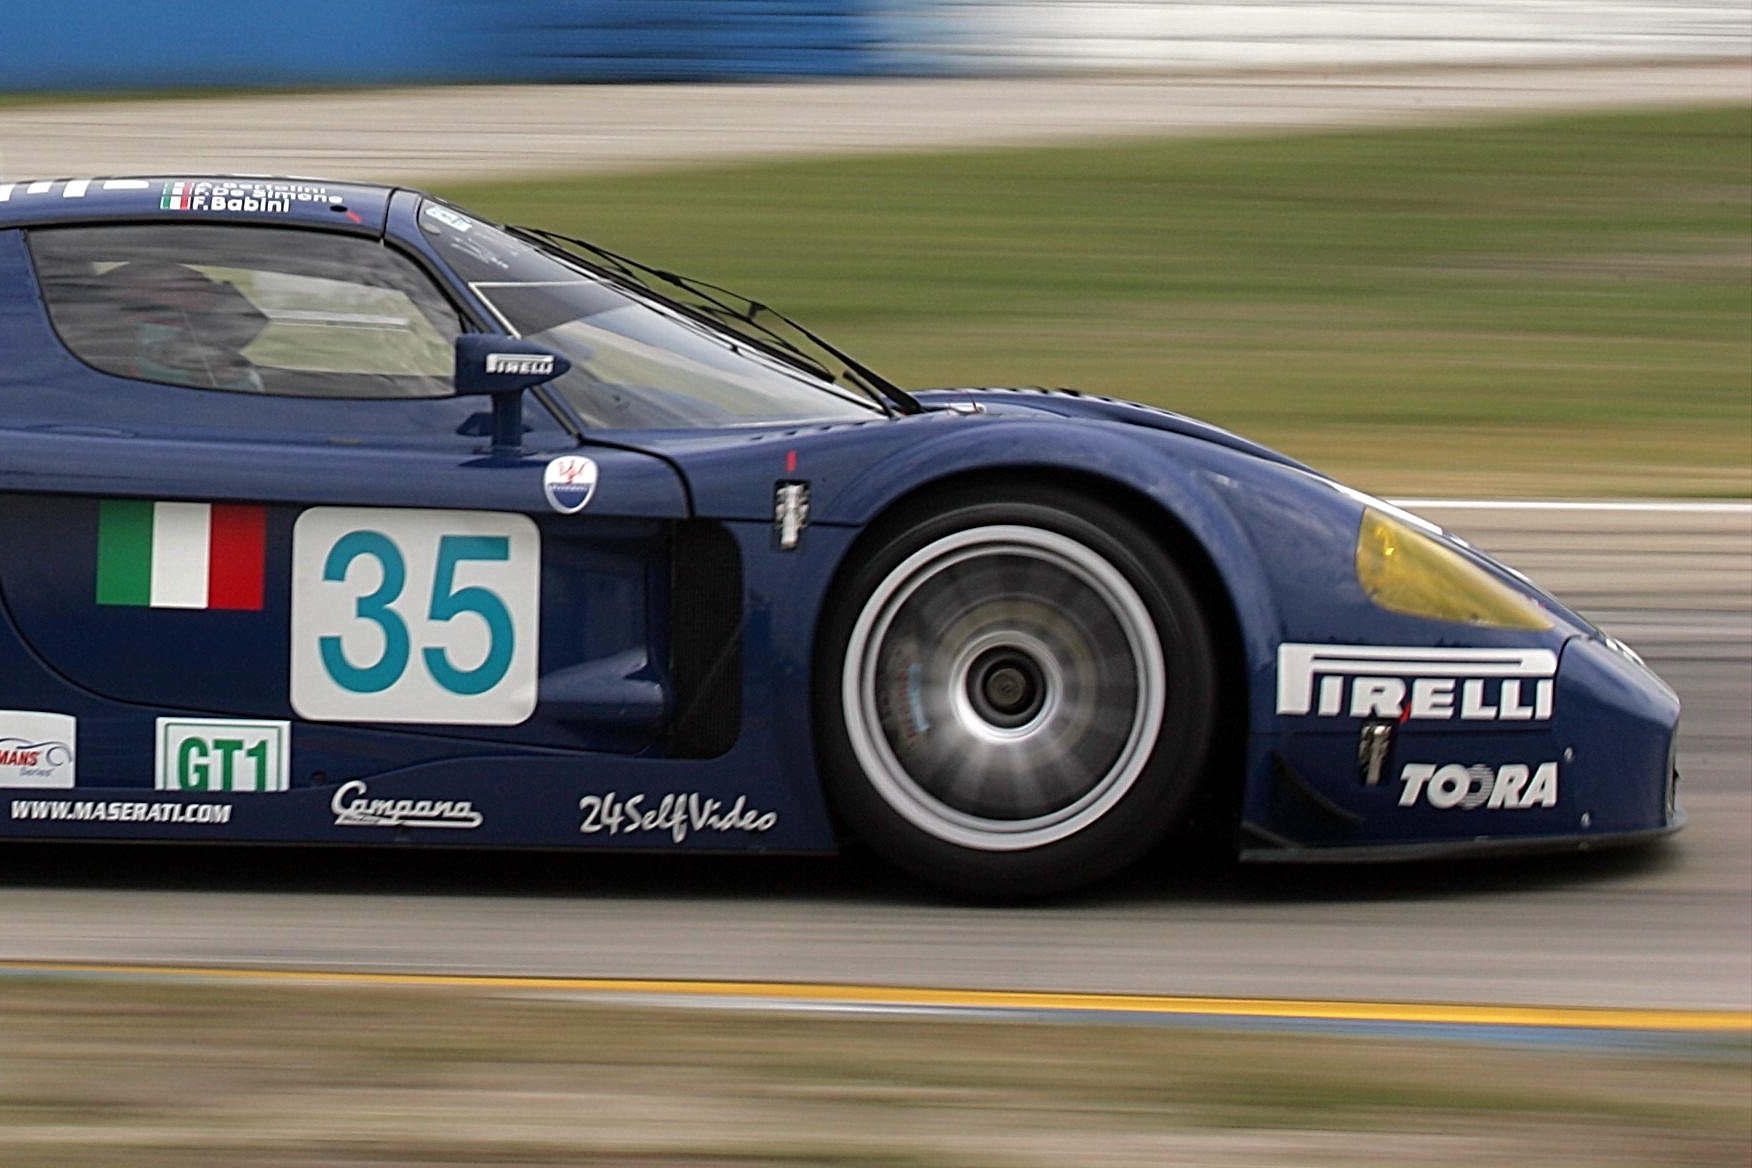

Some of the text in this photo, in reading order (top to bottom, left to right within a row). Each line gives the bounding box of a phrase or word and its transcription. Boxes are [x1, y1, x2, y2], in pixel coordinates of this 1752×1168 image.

[192, 196, 290, 213] F.Babini
[486, 353, 555, 375] PIRELLI
[318, 529, 515, 695] 35
[1276, 643, 1557, 720] PIRELLI
[178, 737, 268, 792] GT1
[1398, 762, 1558, 809] TOORA
[11, 800, 232, 823] WWW.MASERATI.COM
[331, 780, 482, 828] Campana
